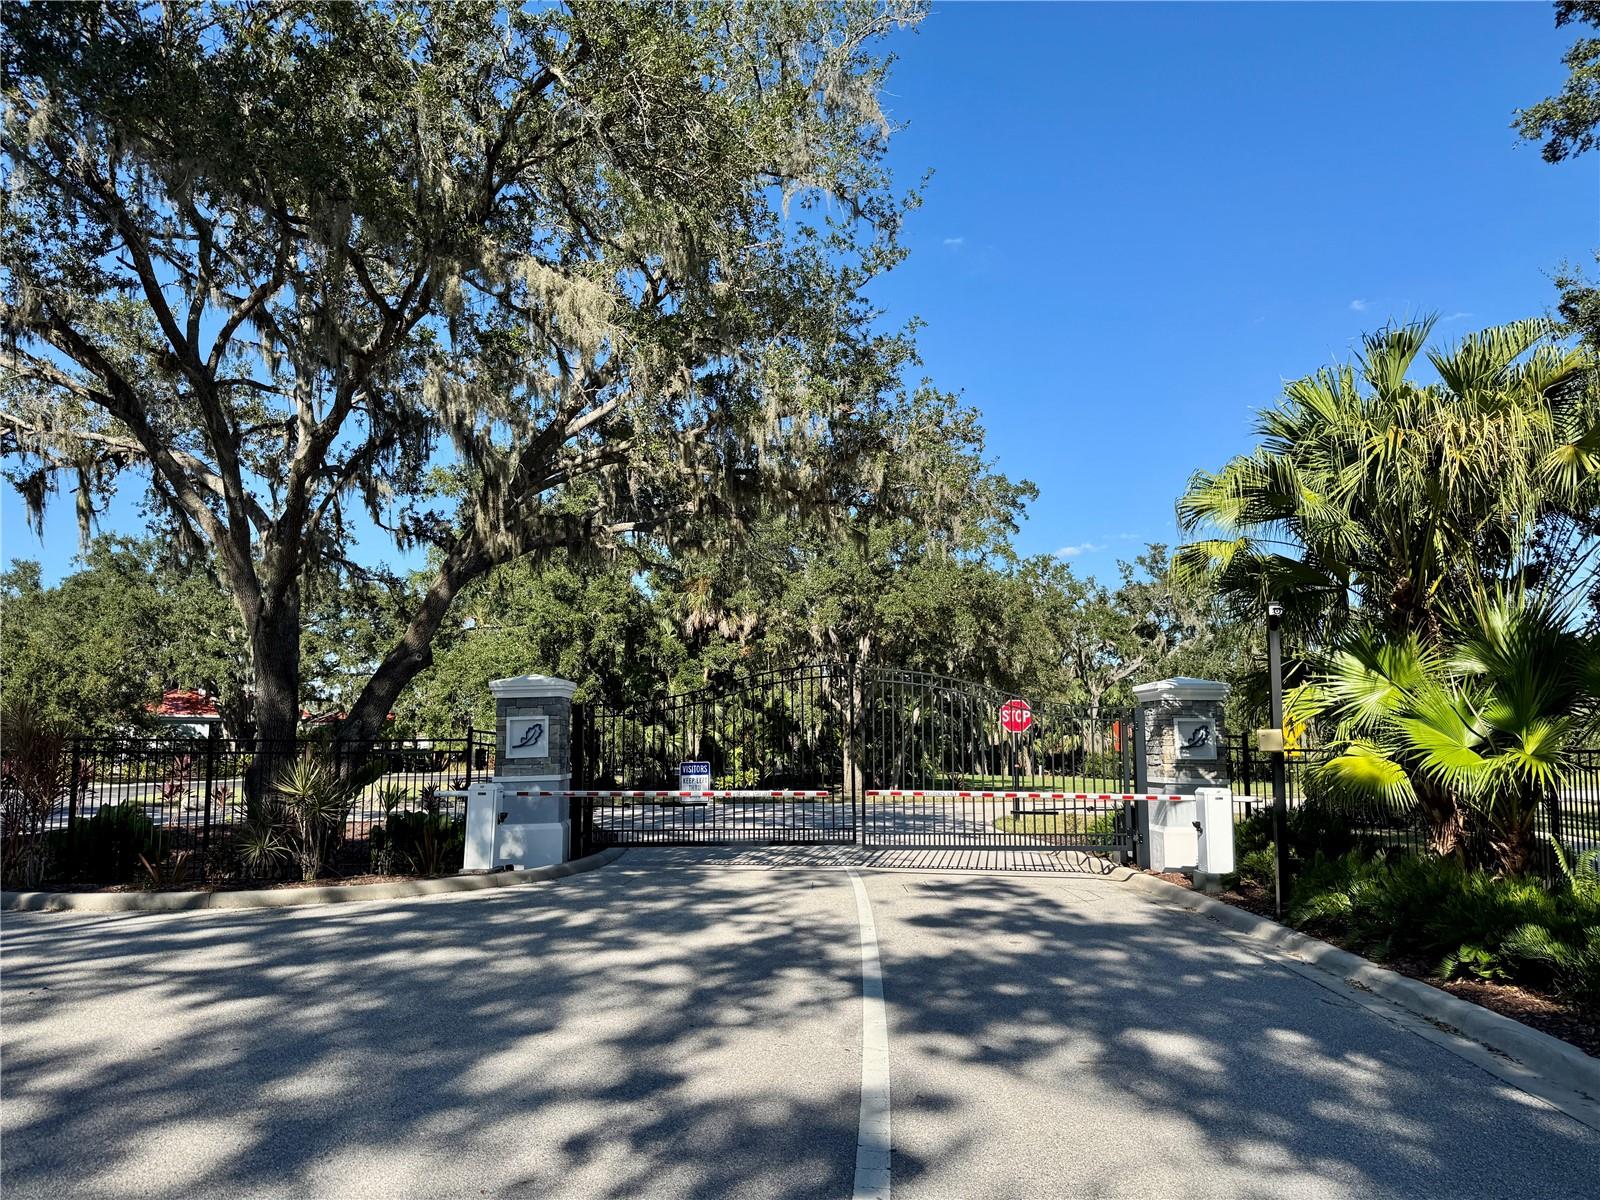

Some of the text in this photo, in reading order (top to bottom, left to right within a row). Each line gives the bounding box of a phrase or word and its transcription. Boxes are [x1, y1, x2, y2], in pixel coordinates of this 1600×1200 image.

[1002, 710, 1031, 722] STOP
[682, 765, 708, 773] VISITORS
[682, 777, 695, 785] KEEP
